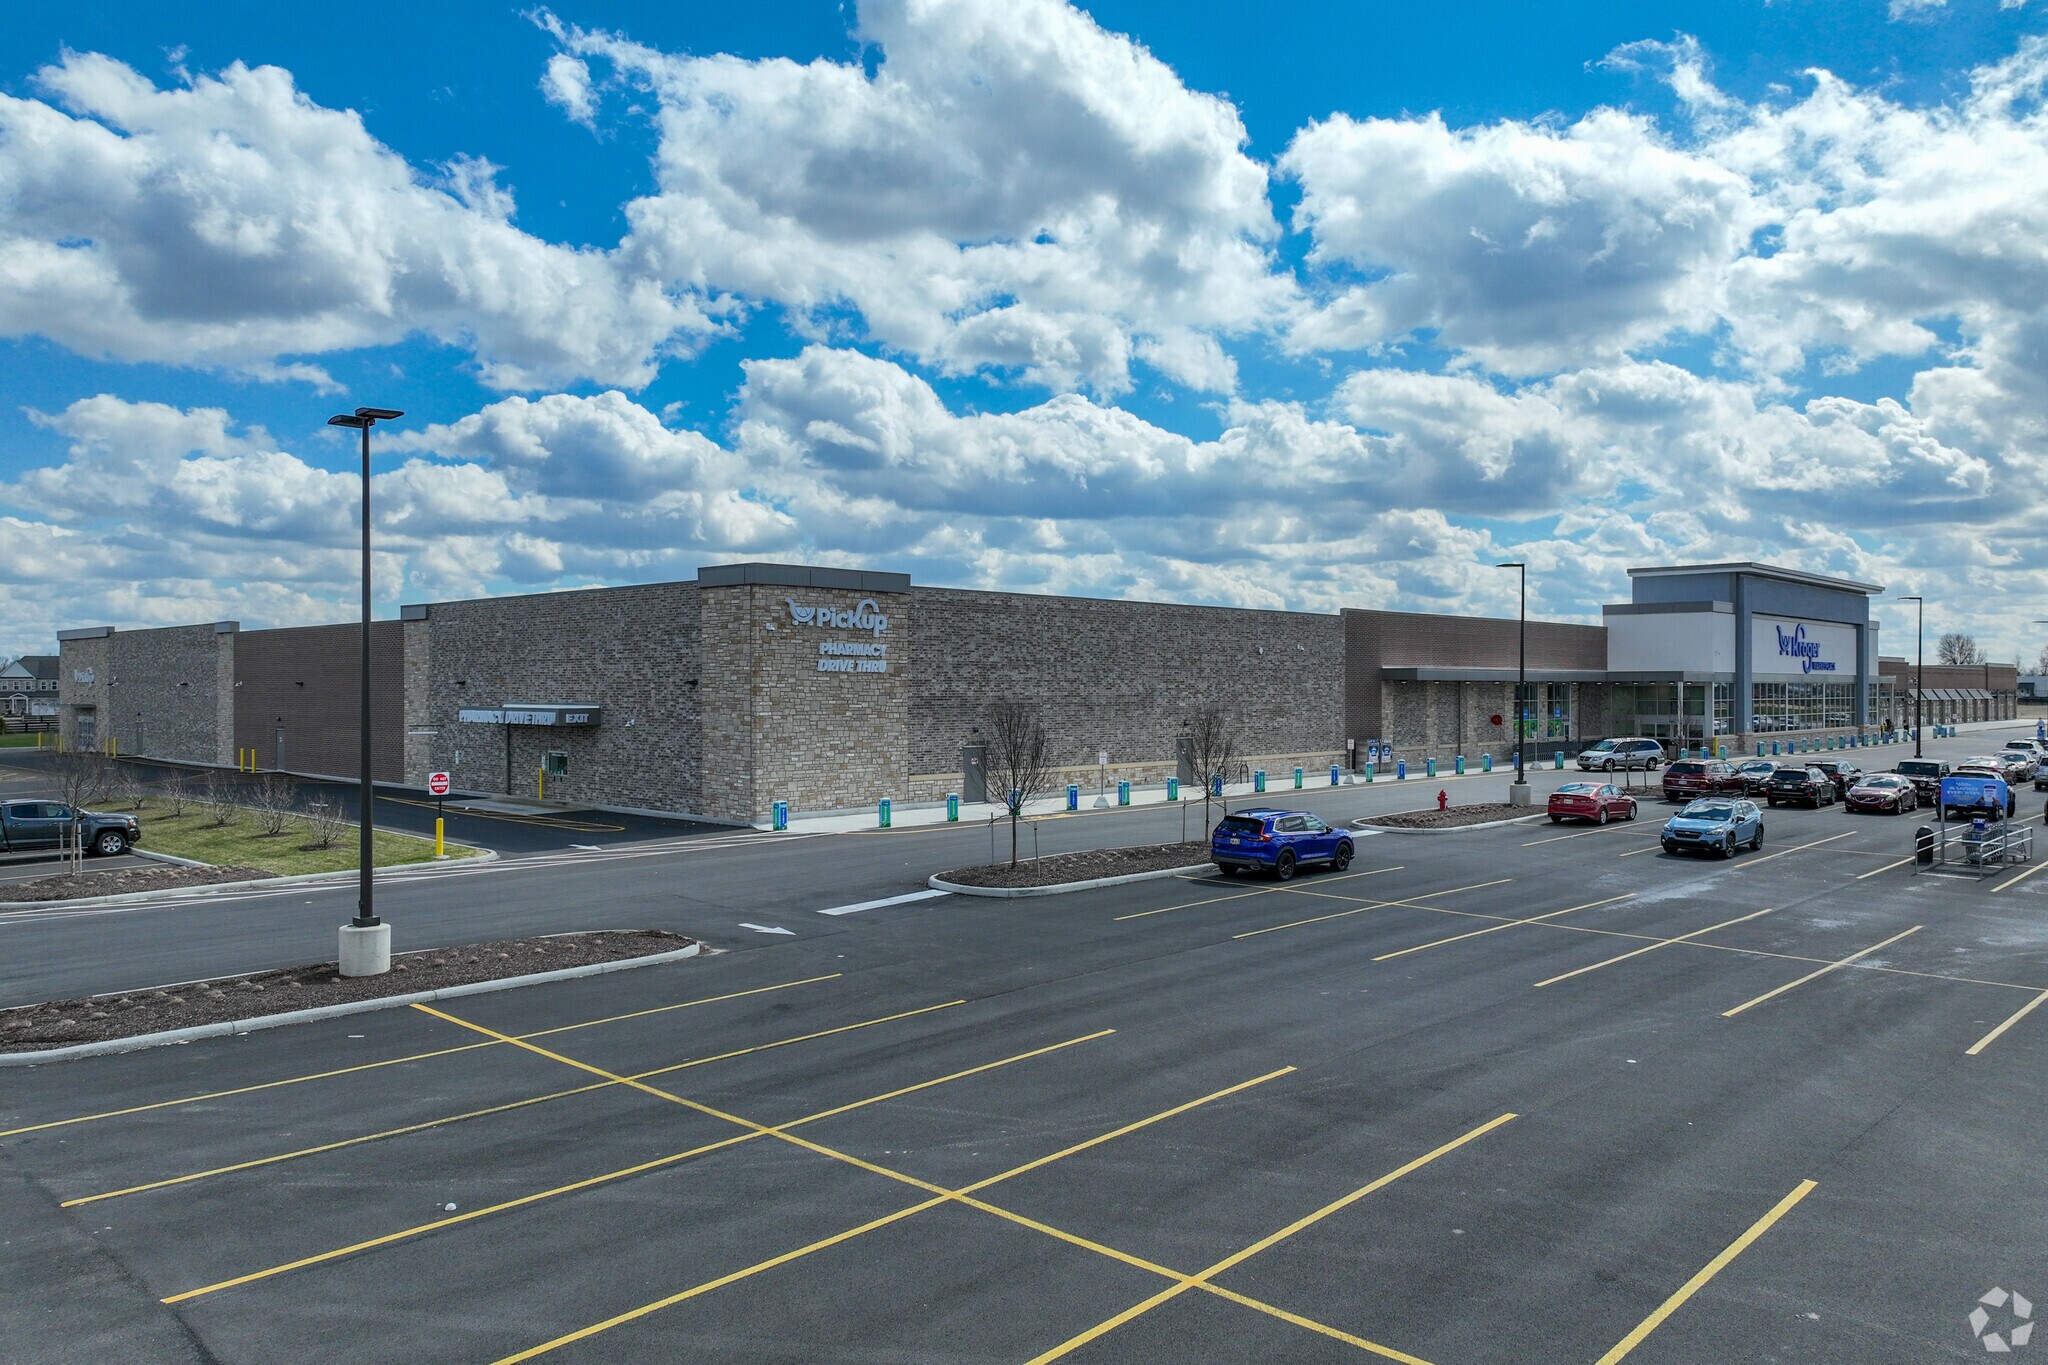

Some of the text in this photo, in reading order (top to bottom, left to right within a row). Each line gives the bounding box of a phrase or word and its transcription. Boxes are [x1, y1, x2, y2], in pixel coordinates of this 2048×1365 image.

[819, 642, 889, 656] PHARMACY
[1791, 623, 1819, 674] Kroger
[817, 659, 887, 673] DRIVE THRU
[565, 713, 589, 724] EXIT
